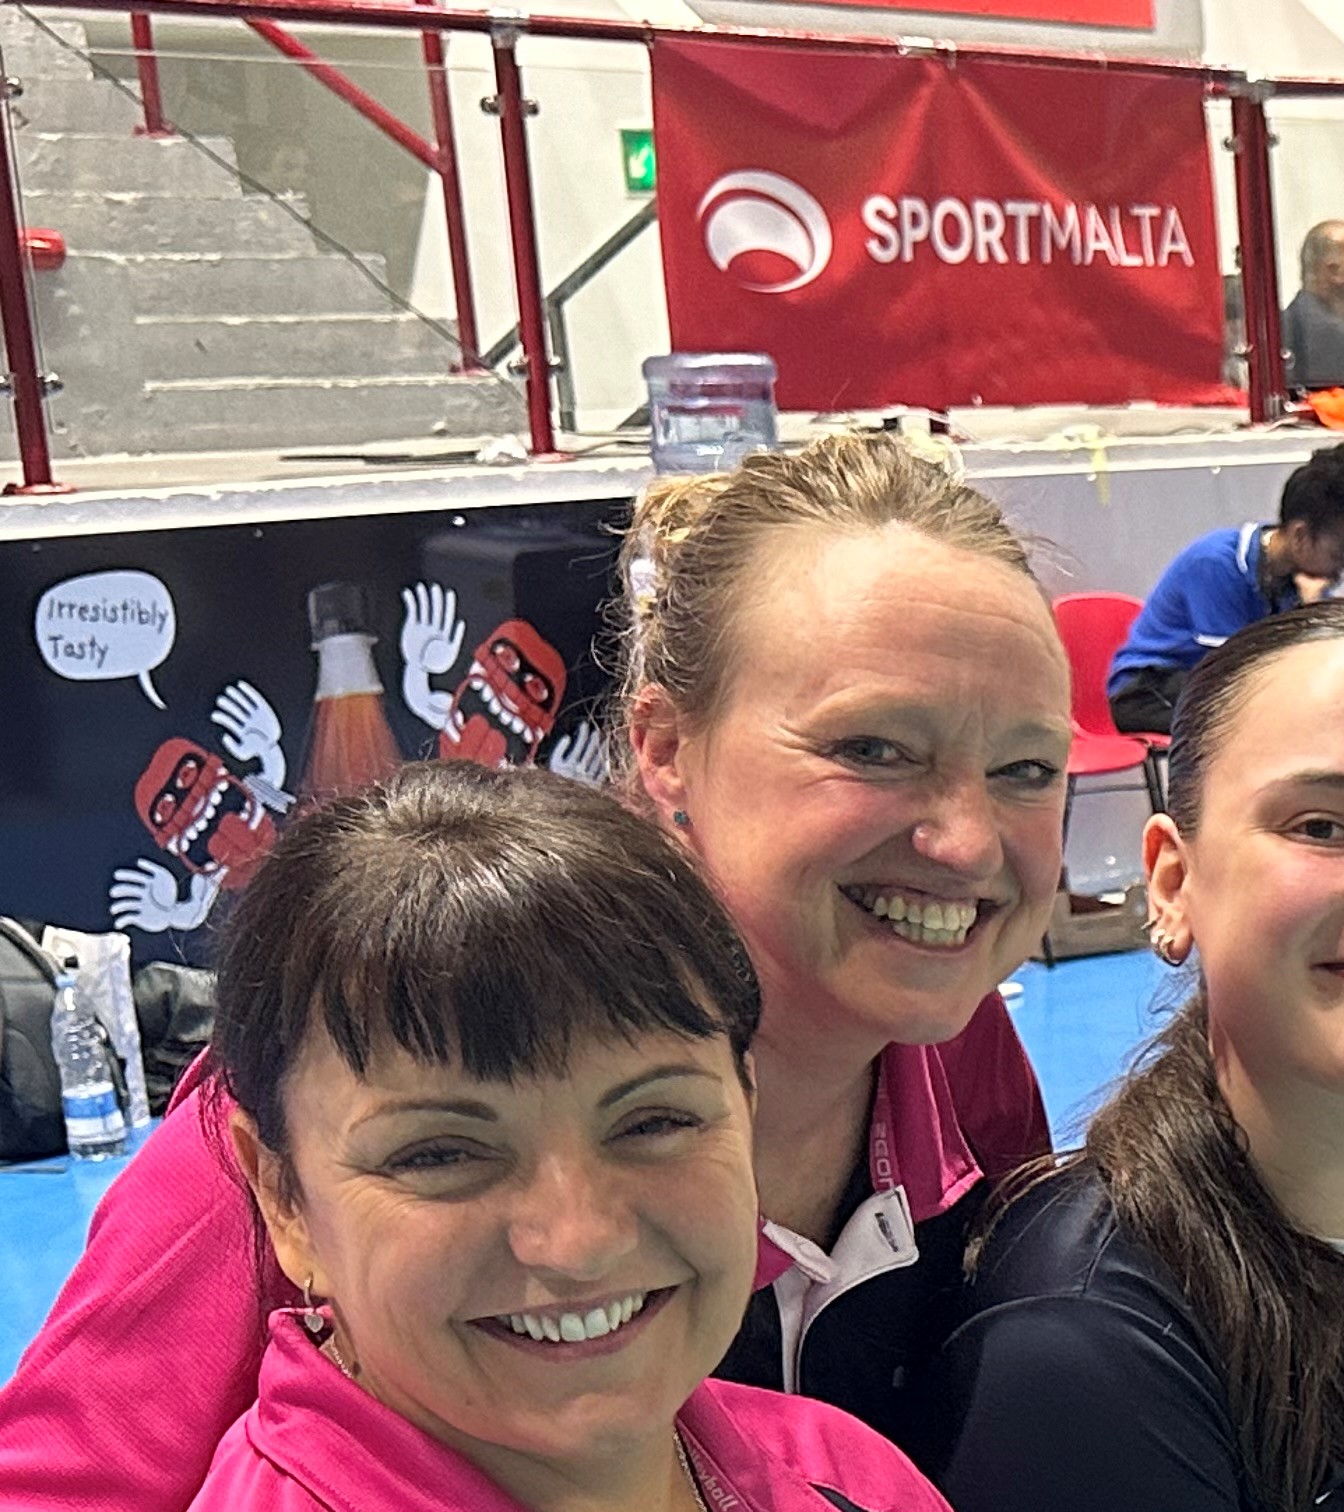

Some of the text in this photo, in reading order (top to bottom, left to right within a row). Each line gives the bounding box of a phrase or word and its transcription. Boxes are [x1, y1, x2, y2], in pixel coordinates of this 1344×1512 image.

[862, 196, 1196, 268] SPORTMALTA
[48, 598, 168, 634] Irresistibly
[48, 635, 109, 668] Tasty
